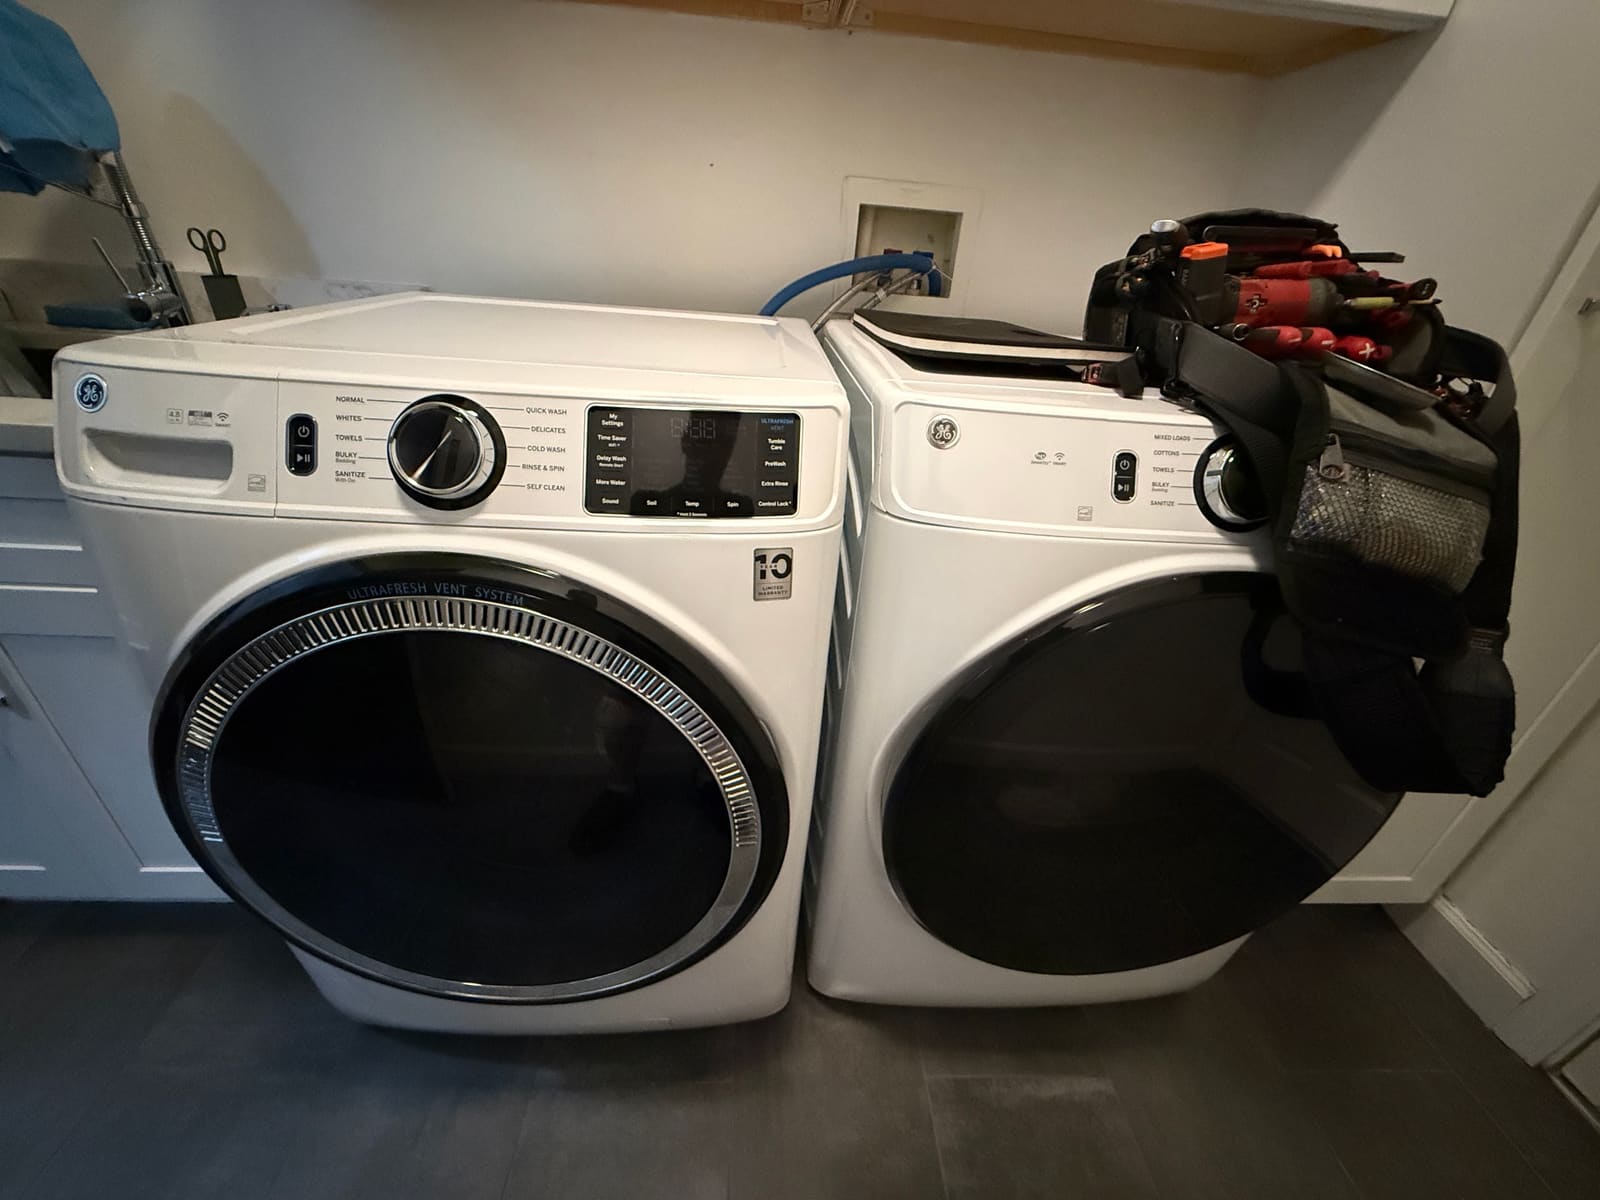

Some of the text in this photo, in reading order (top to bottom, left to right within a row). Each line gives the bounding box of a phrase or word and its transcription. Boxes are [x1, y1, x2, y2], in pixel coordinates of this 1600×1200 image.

[335, 470, 366, 478] SANITIZE
[685, 500, 700, 508] Temp
[754, 553, 792, 579] 10
[346, 582, 524, 606] ULTRAFRESH VENT SYSTEM
